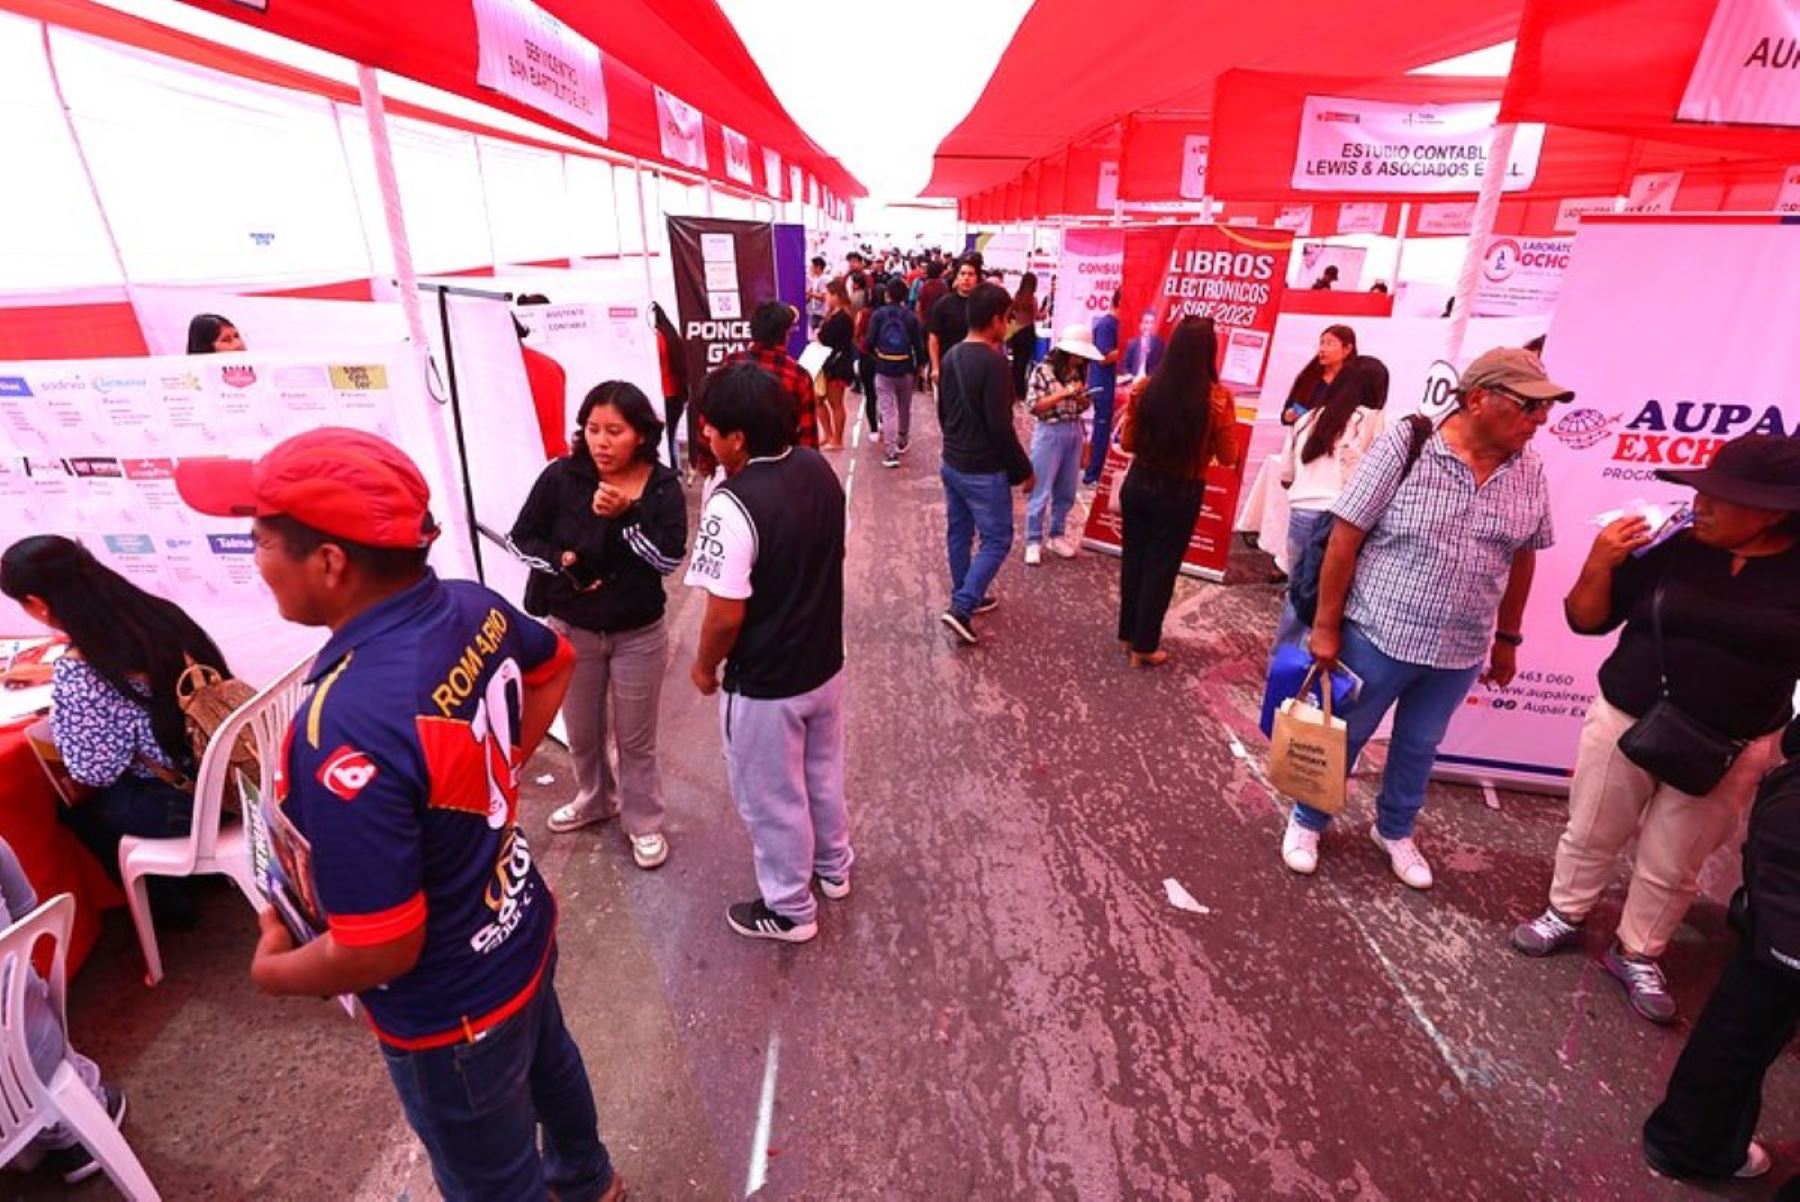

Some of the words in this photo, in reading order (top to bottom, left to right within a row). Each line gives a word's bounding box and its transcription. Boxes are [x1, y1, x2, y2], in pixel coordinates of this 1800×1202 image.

[1341, 143, 1410, 160] ESTUDIO
[1413, 145, 1487, 161] CONTABL
[1305, 159, 1359, 176] LEWIS
[1361, 161, 1373, 177] &
[1375, 160, 1469, 178] ASOCIADOS
[1078, 262, 1120, 275] CONSU
[1169, 248, 1275, 280] LIBROS
[1163, 275, 1270, 304] ELECTRÓNICOS
[1213, 303, 1257, 326] 2023
[686, 321, 752, 340] PONCE
[1422, 376, 1451, 406] 10
[1626, 399, 1800, 438] AUPA
[1612, 434, 1726, 466] EXCH
[1602, 467, 1660, 482] PROGR
[1570, 706, 1586, 718] Ex
